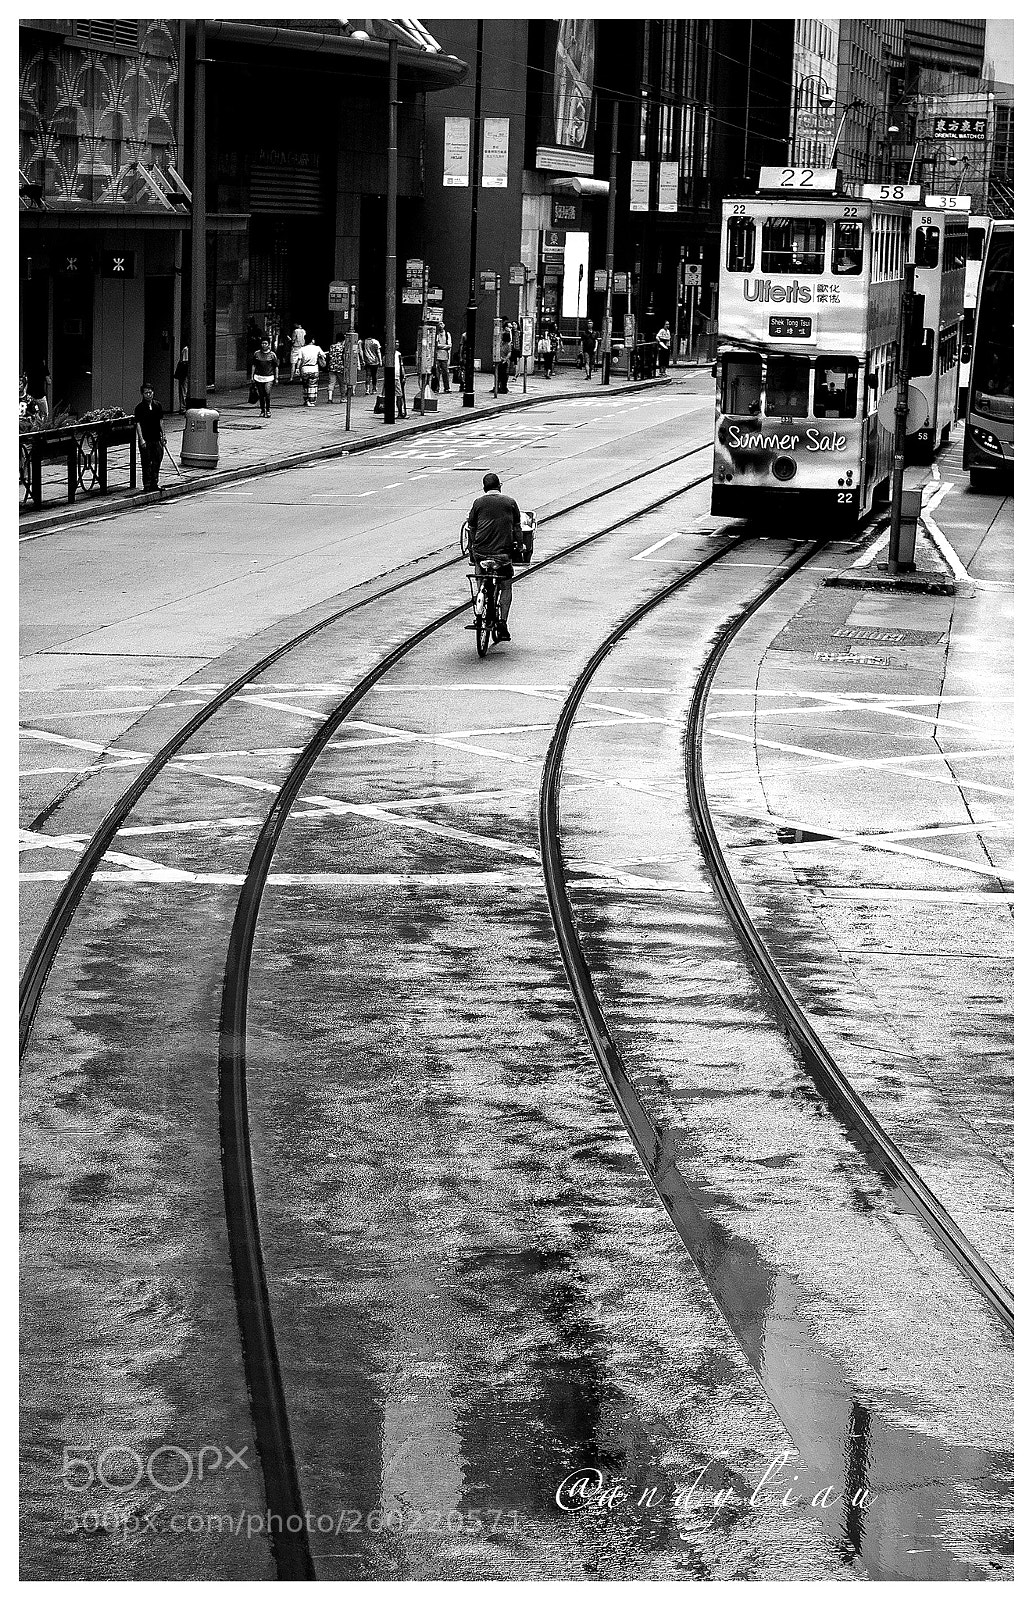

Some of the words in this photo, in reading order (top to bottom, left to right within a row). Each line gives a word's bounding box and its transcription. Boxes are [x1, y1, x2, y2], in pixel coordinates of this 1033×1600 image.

[935, 119, 985, 132] 東方表行
[780, 169, 815, 187] 22
[879, 185, 904, 200] 58
[938, 196, 957, 208] 35
[733, 204, 746, 215] 22
[843, 207, 858, 218] 22
[921, 216, 932, 225] 58
[743, 278, 812, 304] Ulferts
[770, 318, 785, 326] Shek
[786, 318, 799, 328] Tong
[800, 319, 811, 327] Tsui
[728, 425, 800, 450] Summer
[806, 428, 847, 451] Sale
[917, 432, 929, 441] 58
[837, 492, 853, 504] 22
